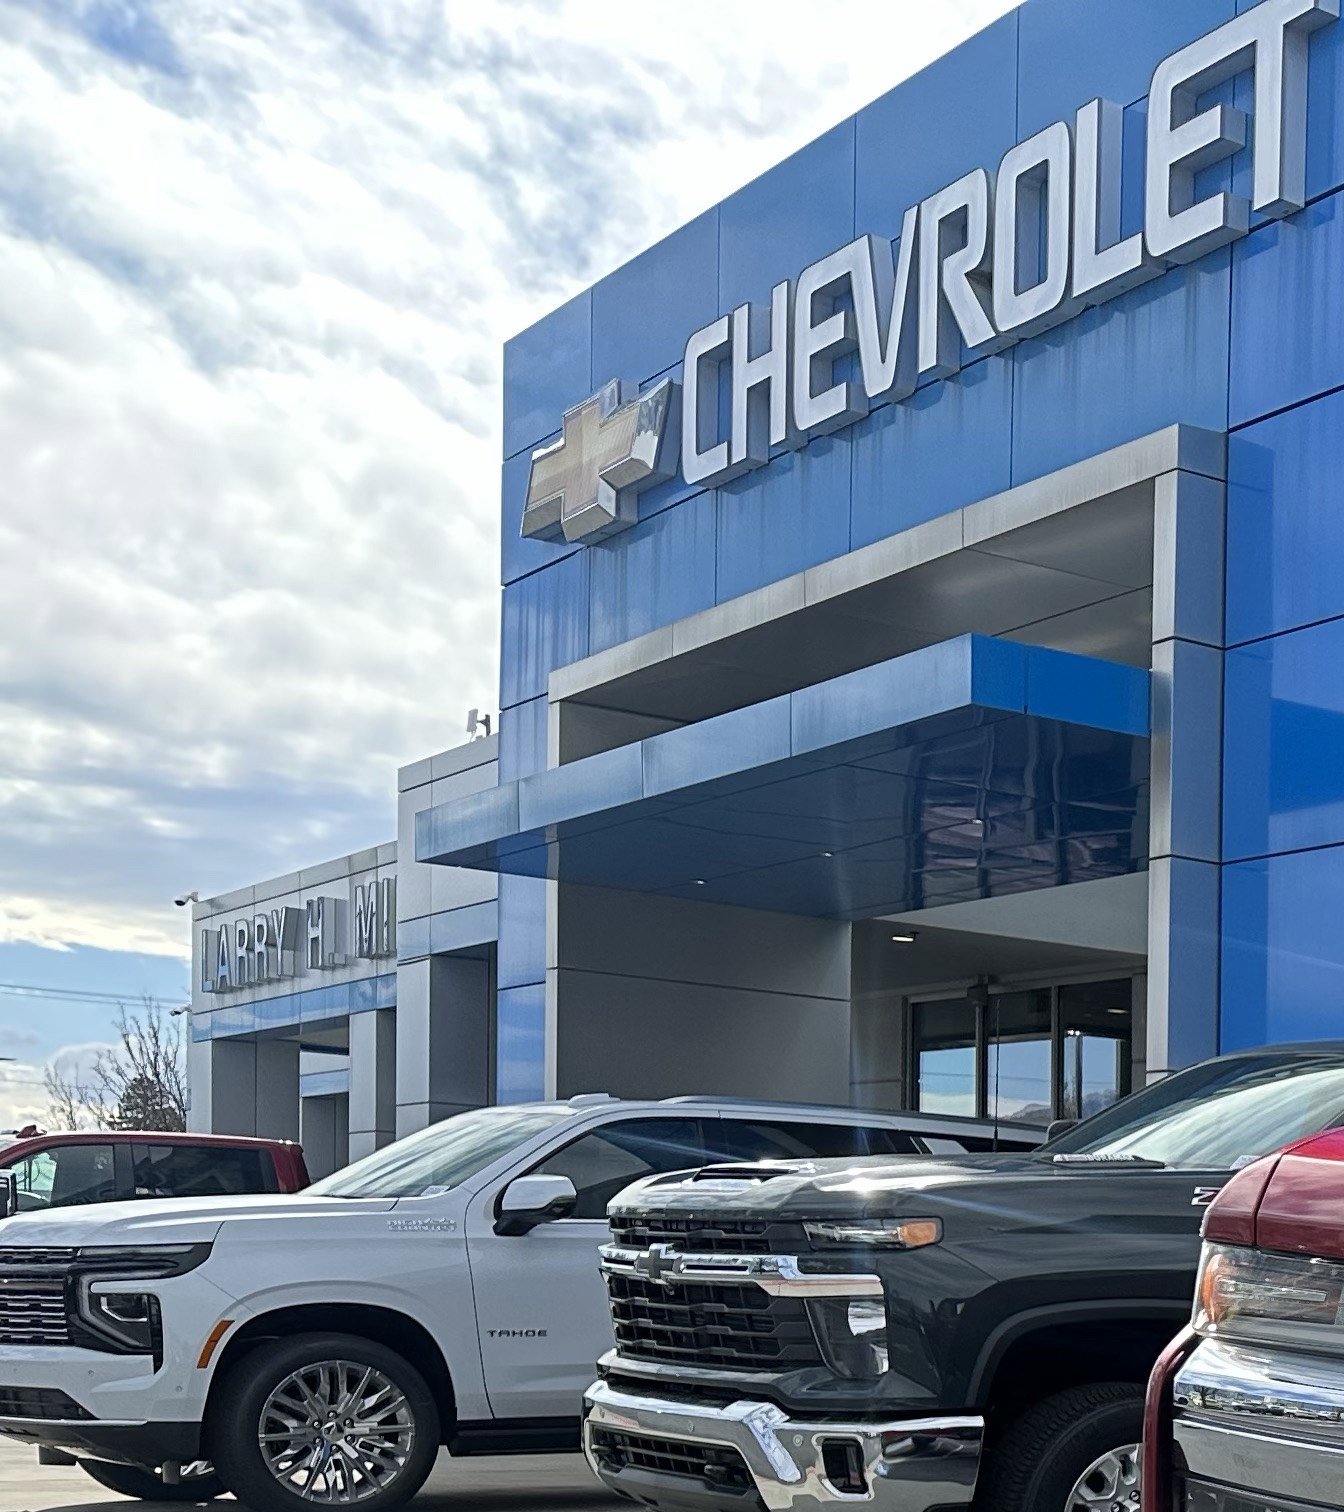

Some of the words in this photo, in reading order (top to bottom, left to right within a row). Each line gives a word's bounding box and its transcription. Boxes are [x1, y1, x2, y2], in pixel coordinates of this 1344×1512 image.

[682, 0, 1339, 488] CHEVROLET
[202, 906, 296, 994] LARRY
[355, 874, 397, 959] MI
[487, 1329, 547, 1338] TAHOE
